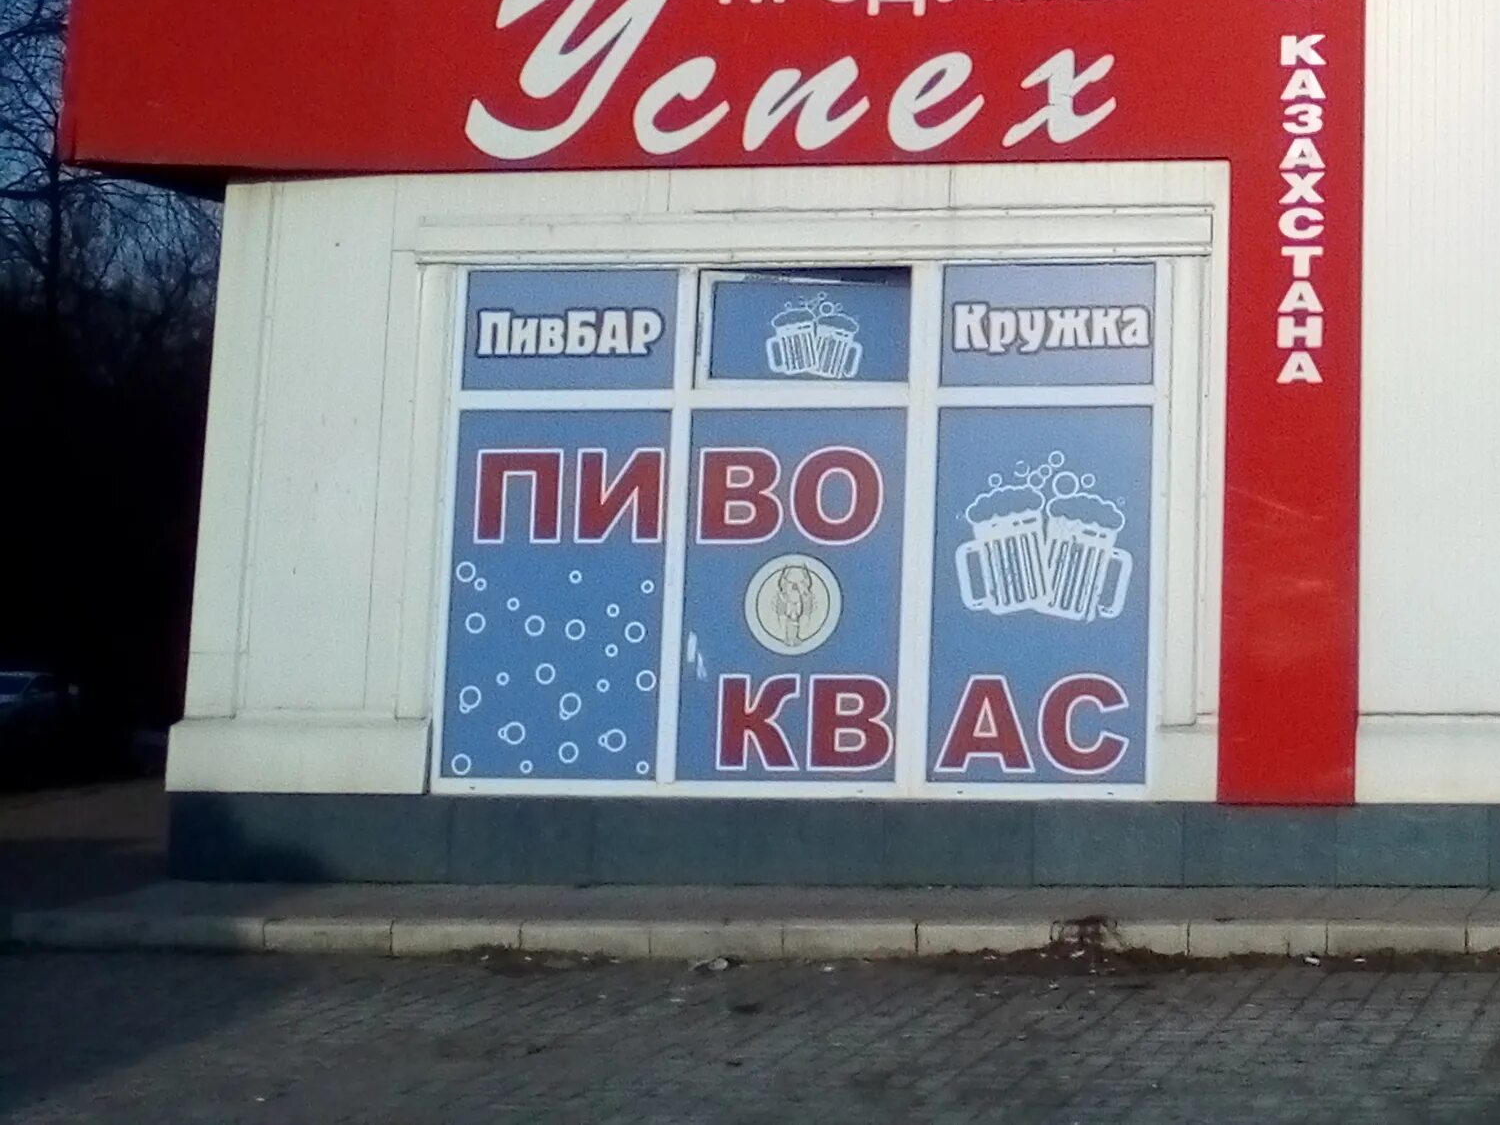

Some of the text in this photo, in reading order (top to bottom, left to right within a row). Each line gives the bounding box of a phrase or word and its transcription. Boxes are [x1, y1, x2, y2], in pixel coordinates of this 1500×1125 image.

[1277, 33, 1326, 385] КАЗАХСТАНА
[476, 301, 1151, 357] ПивБАР Кружка
[473, 446, 884, 545] ПИВО
[716, 674, 1130, 773] КВАС
